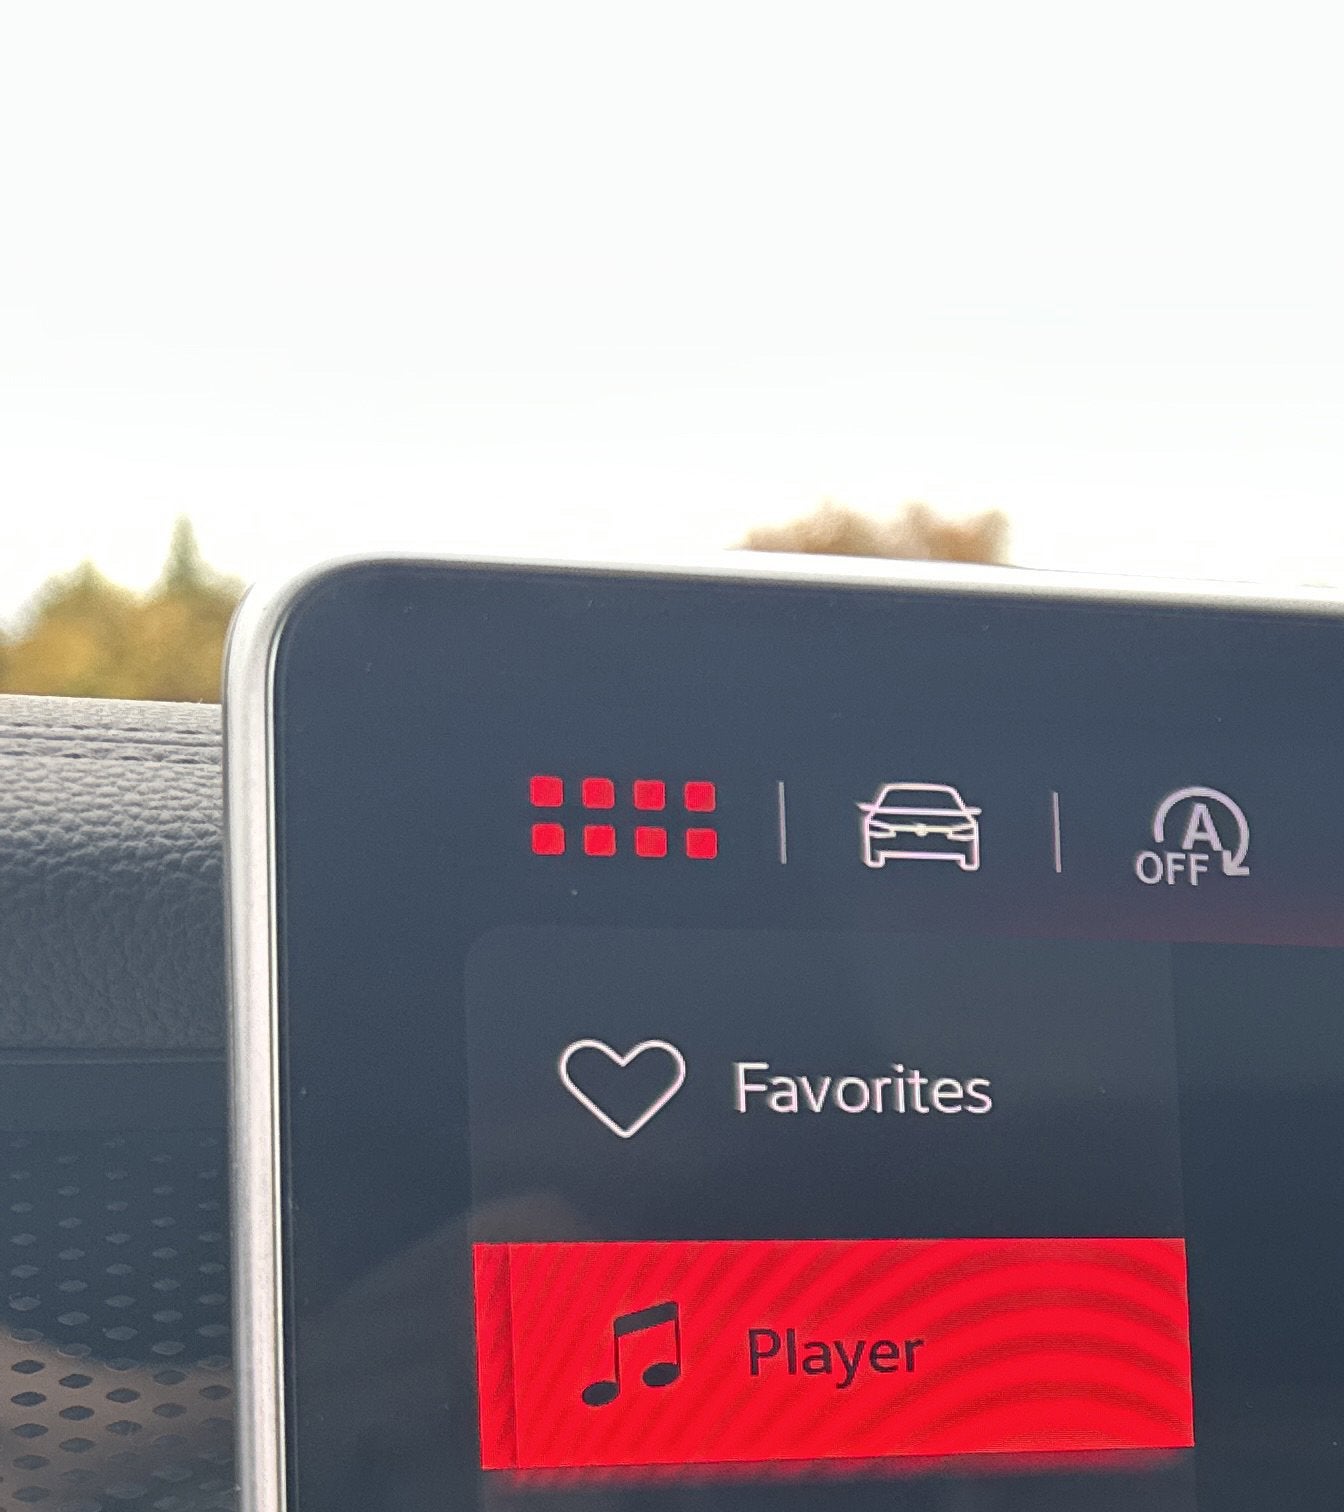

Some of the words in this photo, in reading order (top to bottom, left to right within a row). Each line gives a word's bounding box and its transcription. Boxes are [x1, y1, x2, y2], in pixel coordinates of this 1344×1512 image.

[1136, 851, 1210, 886] OFF
[733, 1061, 993, 1116] Favorites
[749, 1327, 925, 1388] Player
